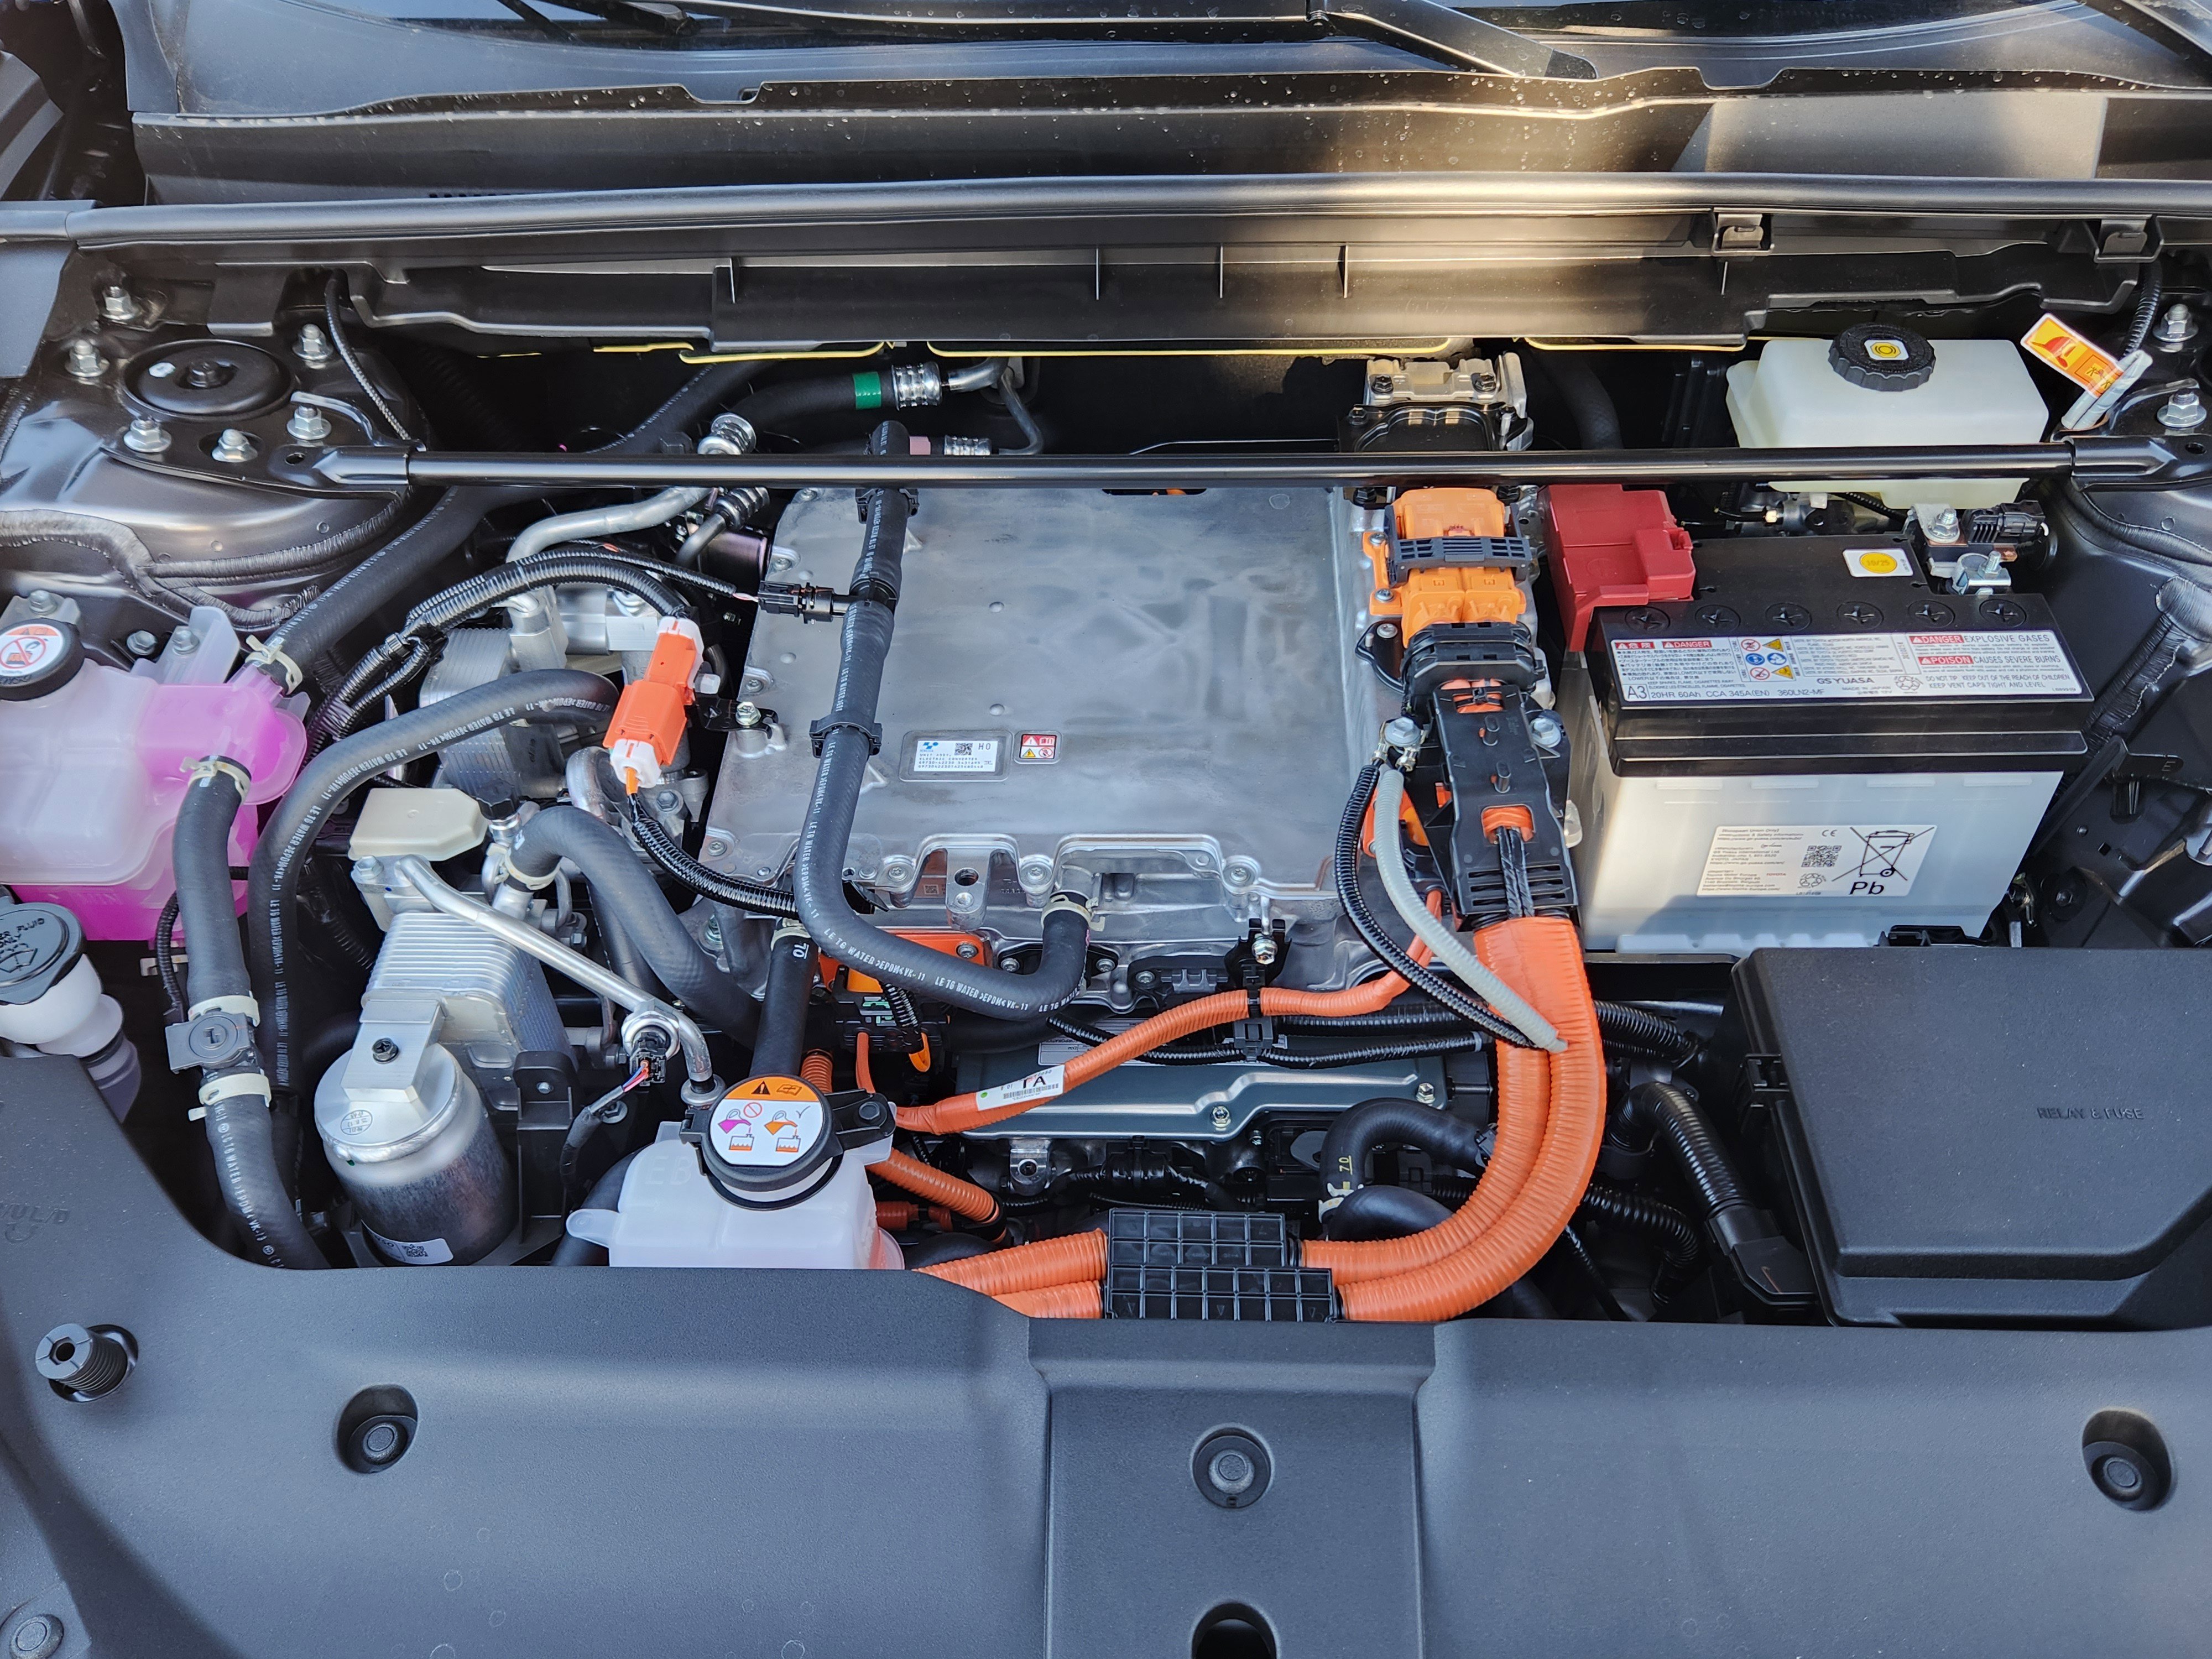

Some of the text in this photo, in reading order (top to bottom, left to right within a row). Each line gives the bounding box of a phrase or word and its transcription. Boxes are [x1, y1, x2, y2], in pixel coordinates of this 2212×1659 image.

[1627, 686, 1647, 699] A3
[469, 716, 494, 732] WATER
[395, 748, 408, 759] LE
[359, 756, 386, 771] WATER
[821, 758, 832, 777] WATER
[310, 805, 322, 816] LE
[809, 821, 818, 830] LE
[290, 823, 311, 846] WATER
[807, 830, 816, 838] TG
[802, 840, 813, 862] WATER
[1850, 881, 1885, 895] Pb
[793, 943, 807, 958] 70
[824, 928, 836, 940] LE
[836, 937, 847, 949] TG
[848, 946, 874, 965] WATER
[935, 976, 946, 987] LE
[946, 979, 954, 990] TG
[957, 983, 978, 998] WATER
[1039, 1004, 1048, 1012] LE
[2037, 1108, 2084, 1120] RELAY
[2104, 1108, 2145, 1120] FUSE
[226, 1154, 242, 1185] WATER
[1338, 1157, 1350, 1172] 70
